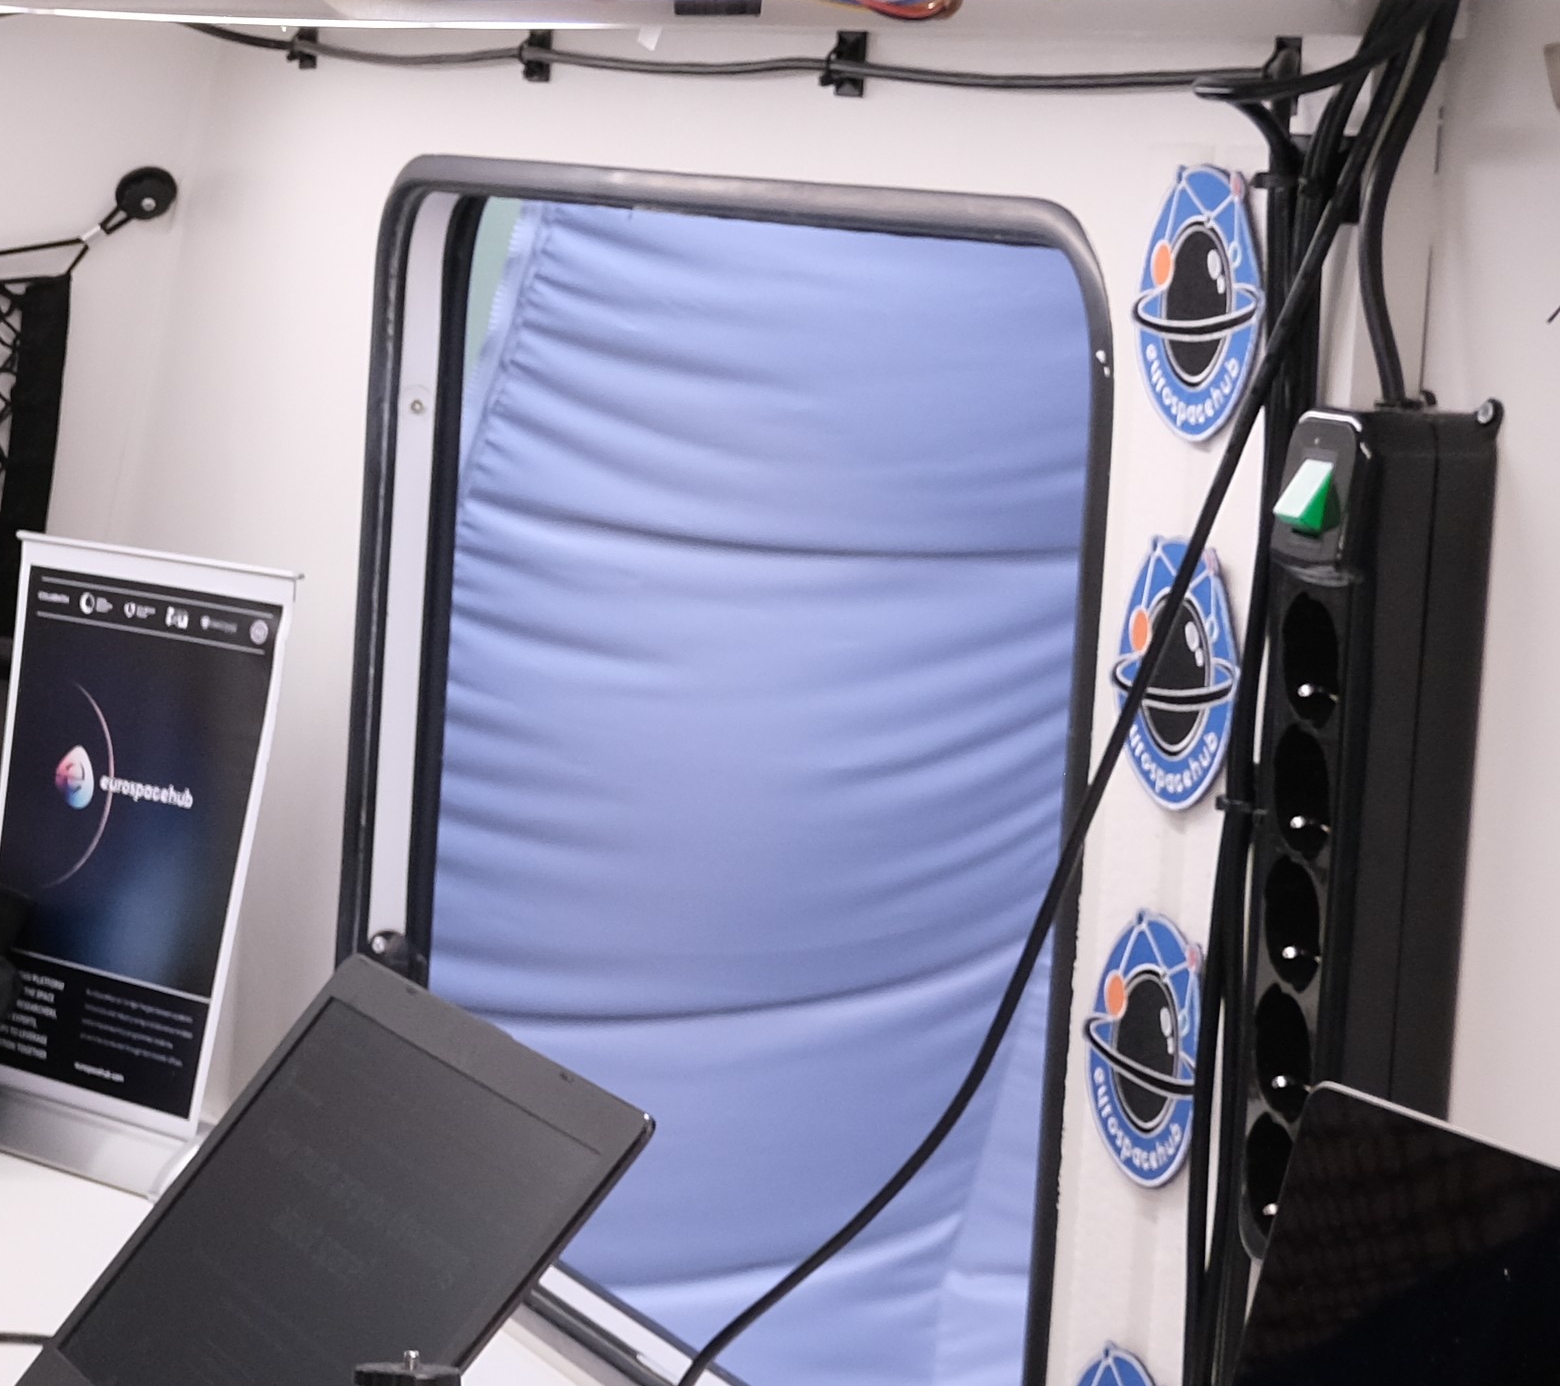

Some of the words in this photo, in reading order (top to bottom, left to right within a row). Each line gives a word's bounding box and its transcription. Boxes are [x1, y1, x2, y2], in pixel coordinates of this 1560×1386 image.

[1145, 343, 1240, 428] eurospacehub
[99, 774, 194, 810] eurospacehub
[1128, 723, 1219, 794] urospacehub
[1093, 1066, 1183, 1172] eurospacehub
